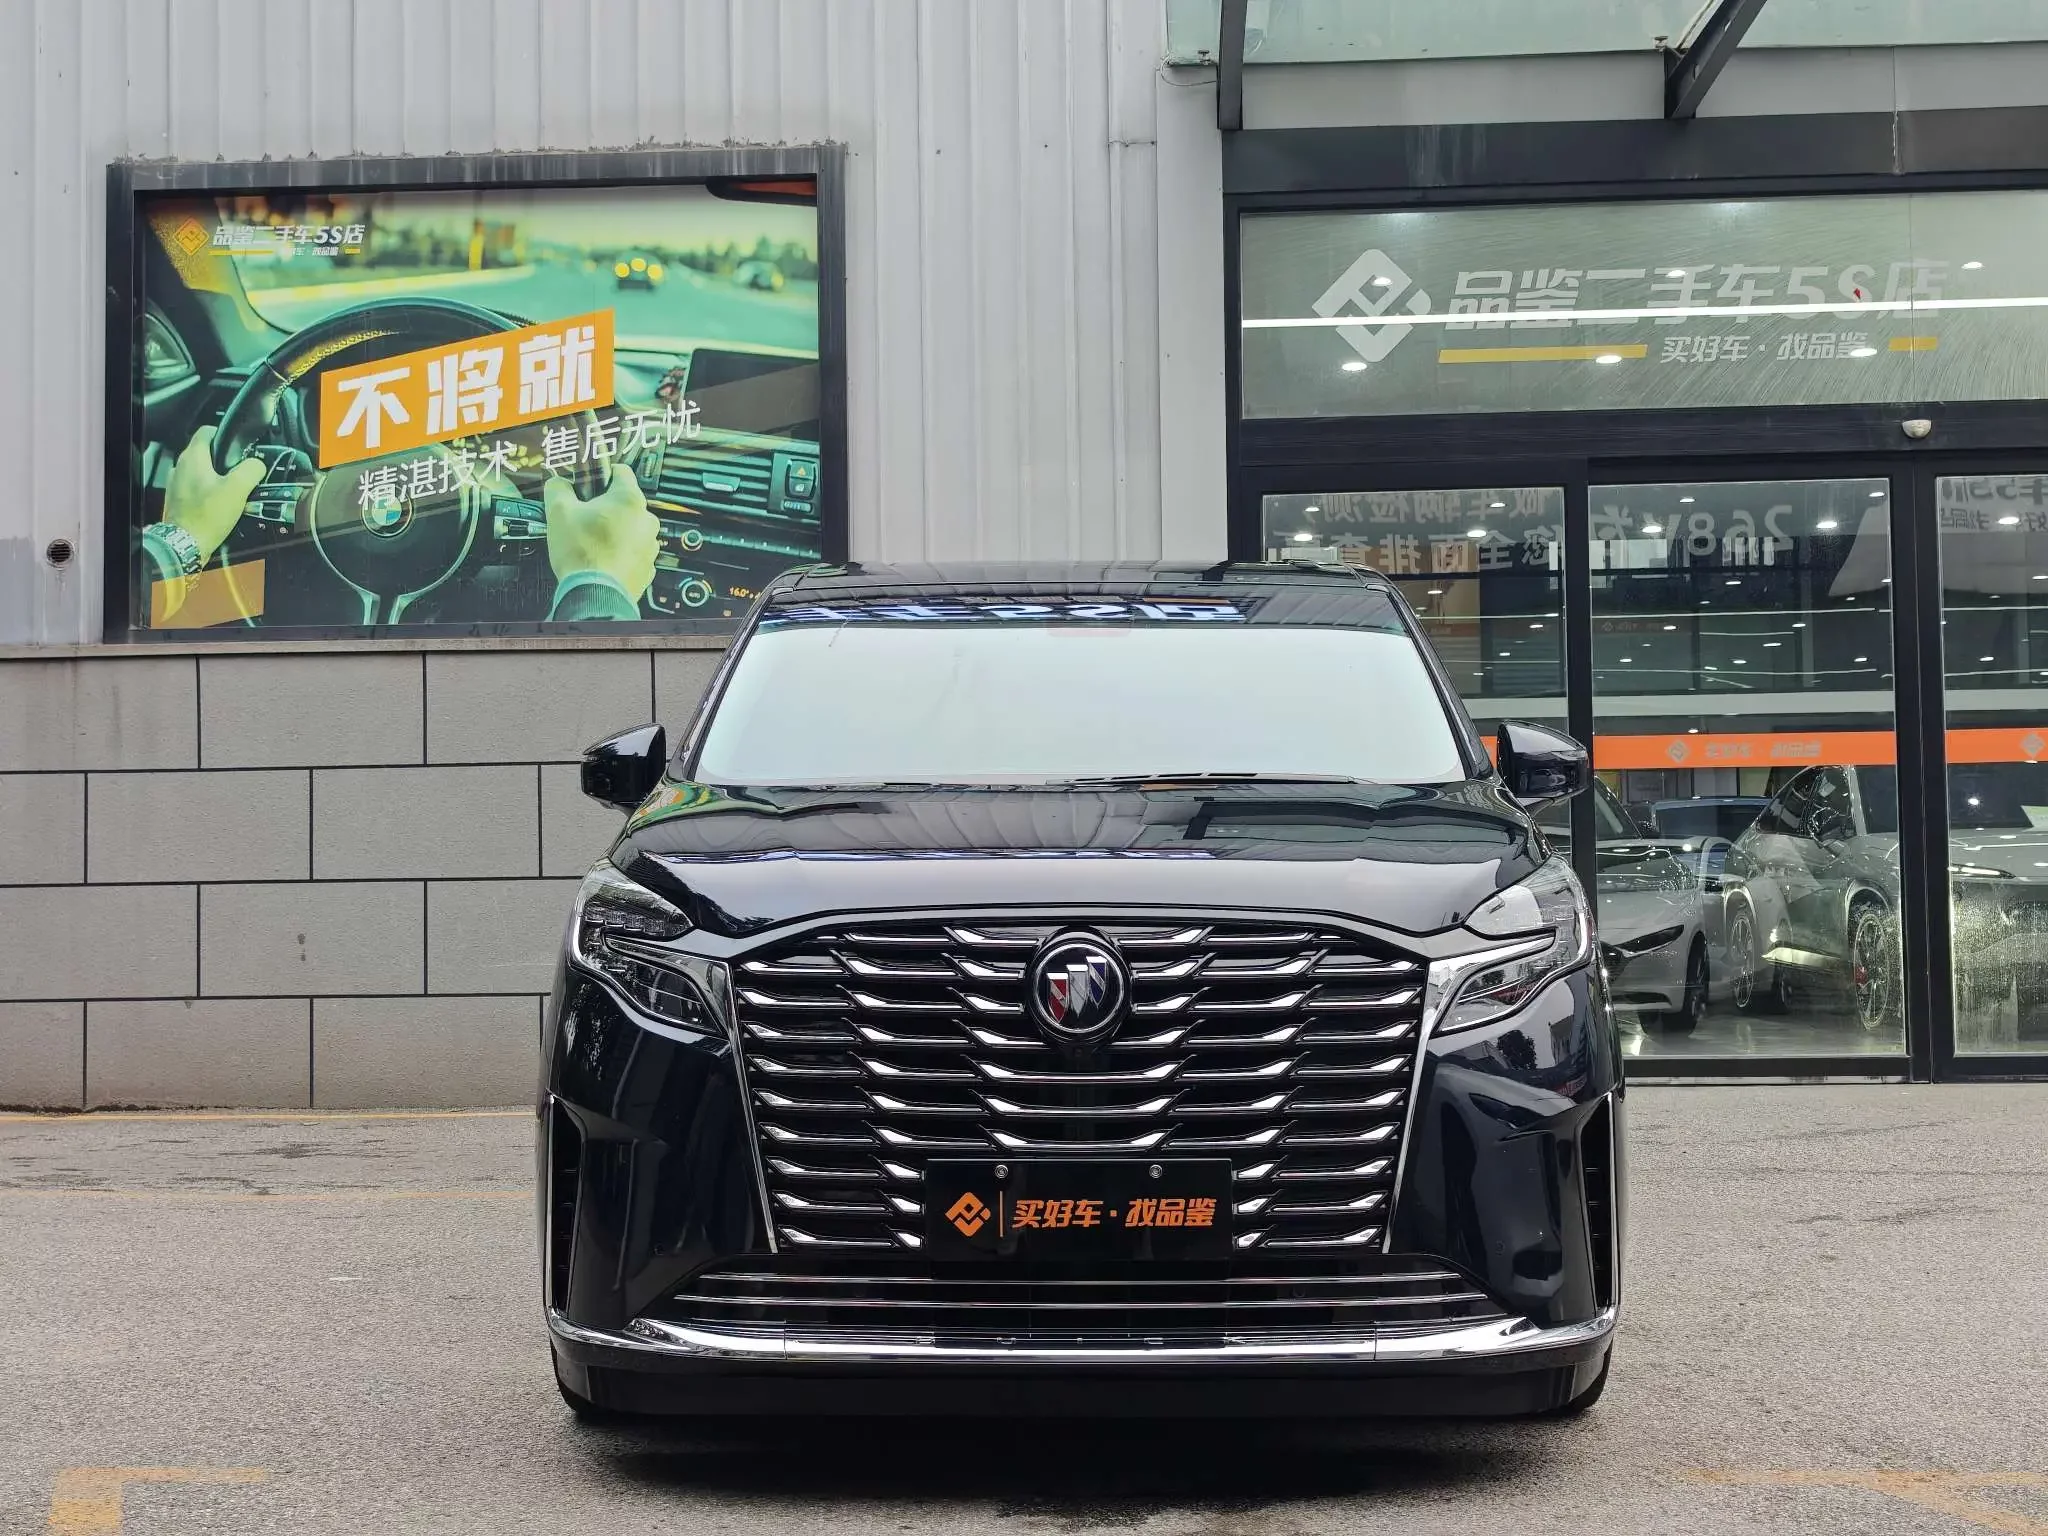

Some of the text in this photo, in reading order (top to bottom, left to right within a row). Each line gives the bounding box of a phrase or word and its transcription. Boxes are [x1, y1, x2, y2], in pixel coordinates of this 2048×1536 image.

[213, 224, 366, 246] 品鉴二手车5S店
[1445, 259, 1950, 331] 品鉴二手车5S店
[336, 325, 597, 449] 不将就
[357, 399, 702, 512] 精湛技术 售后无忧
